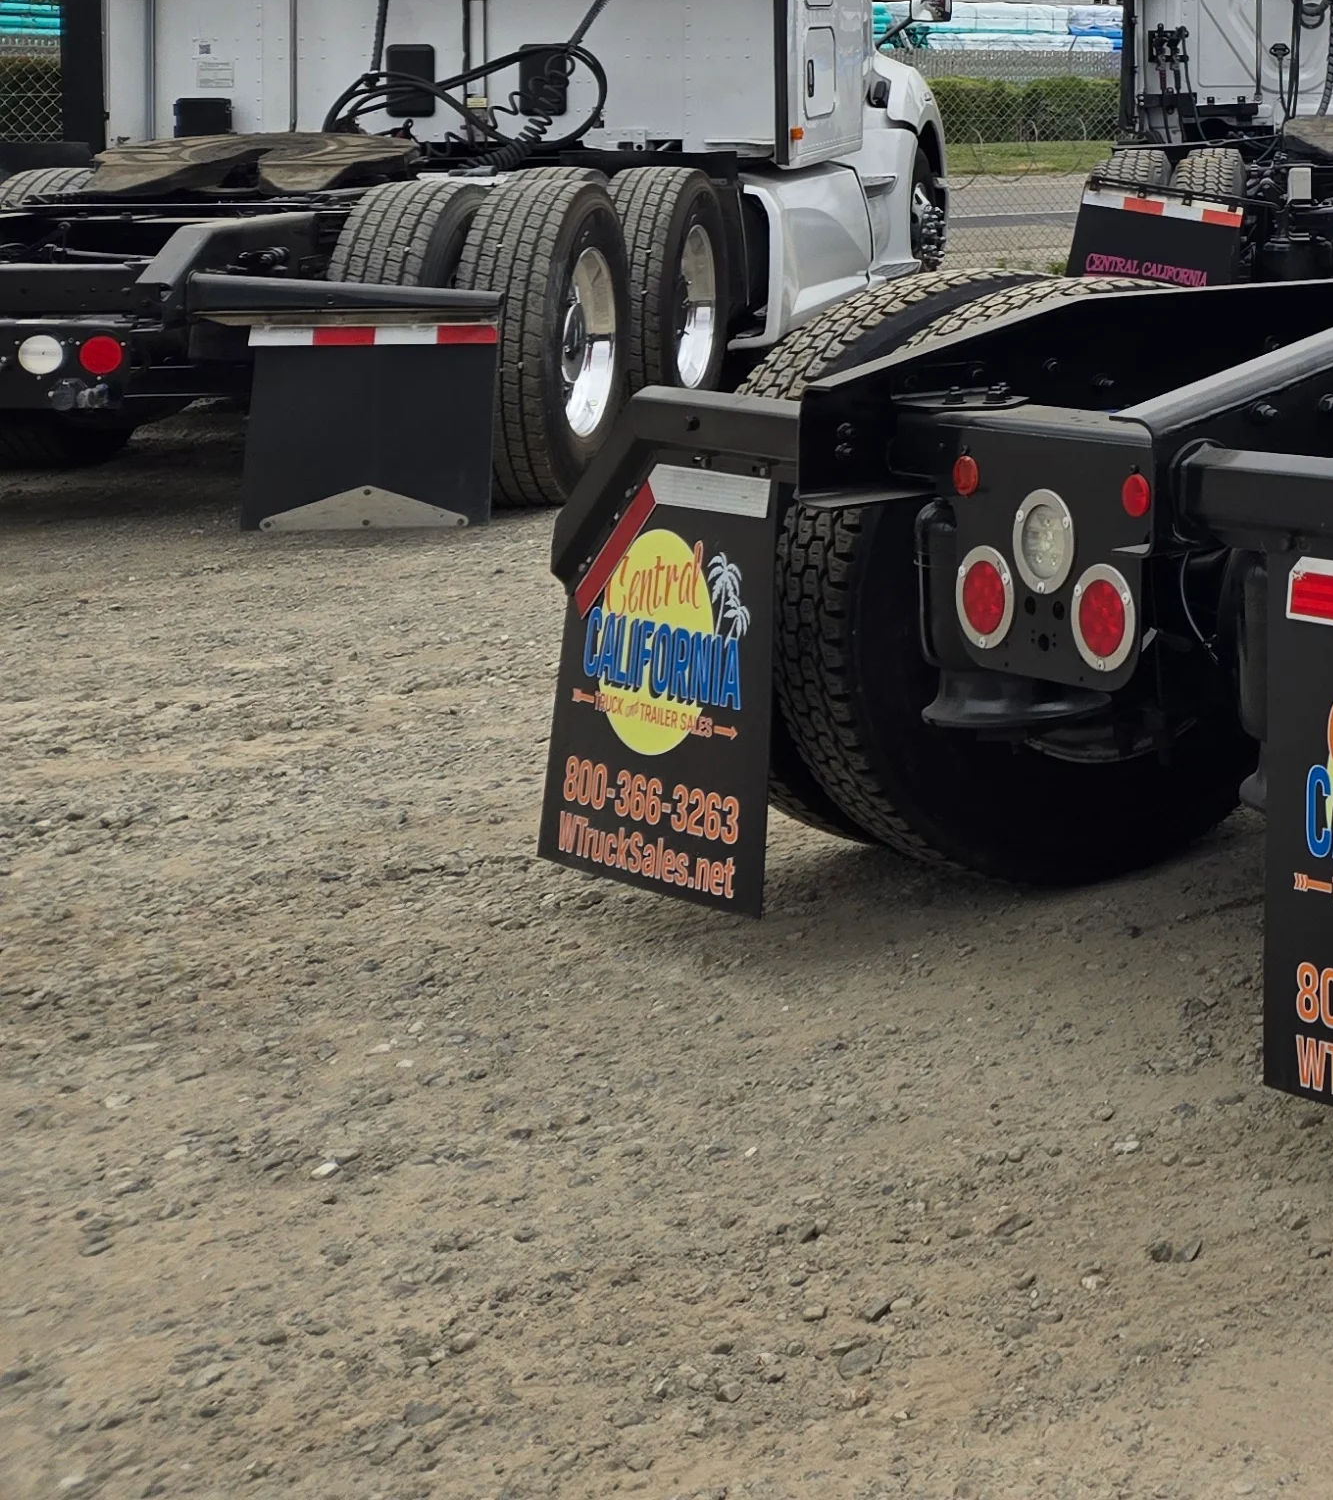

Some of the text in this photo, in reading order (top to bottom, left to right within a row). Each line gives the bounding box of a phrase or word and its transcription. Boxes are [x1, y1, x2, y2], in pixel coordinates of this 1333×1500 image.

[1085, 253, 1208, 287] CENTRAL CALIFORNIA
[604, 540, 704, 618] Central
[583, 606, 741, 711] CALIFORNIA
[594, 690, 713, 739] TRUCK and TRAILER SALES
[563, 755, 740, 845] 800-366-3263
[558, 810, 736, 899] WTruckSales.net
